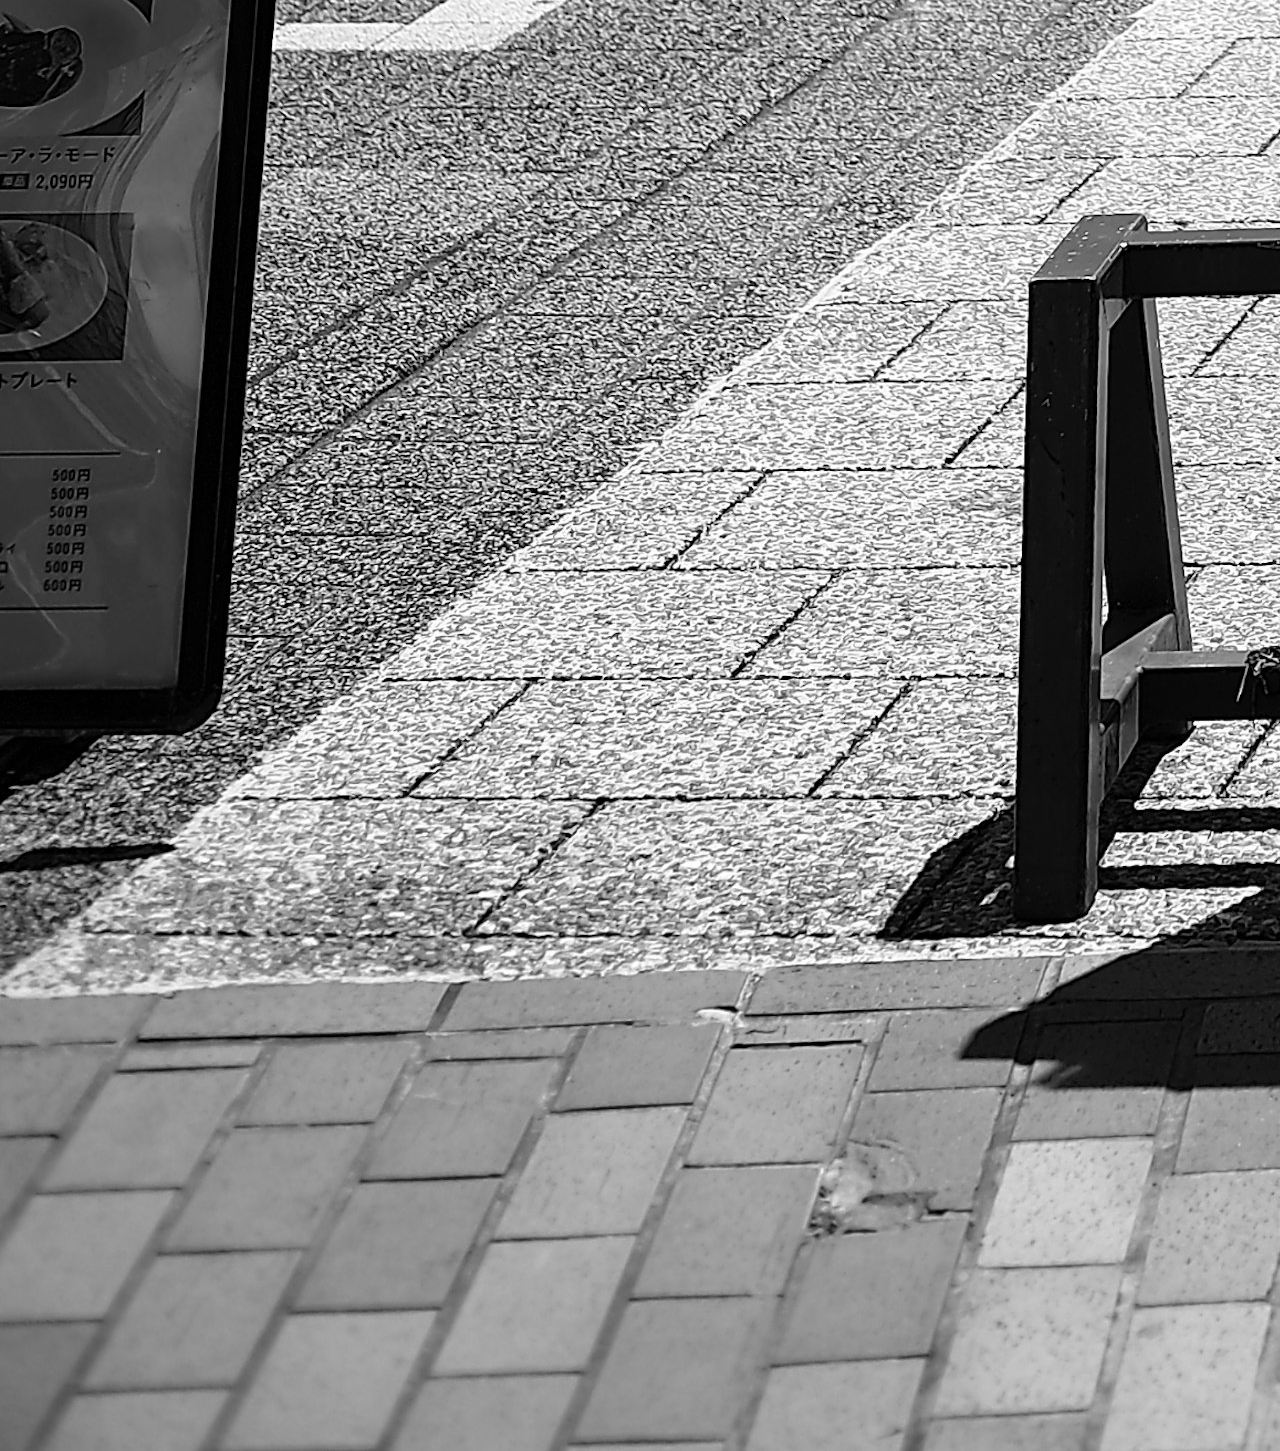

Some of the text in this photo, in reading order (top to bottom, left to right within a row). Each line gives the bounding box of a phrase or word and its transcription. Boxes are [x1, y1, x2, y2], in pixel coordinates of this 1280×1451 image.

[35, 174, 94, 191] 2,090円
[52, 468, 91, 482] 500円
[50, 486, 89, 500] 500円
[49, 504, 88, 518] 500円
[47, 523, 87, 537] 500円
[46, 541, 85, 555] 500円
[44, 559, 83, 574] 500円
